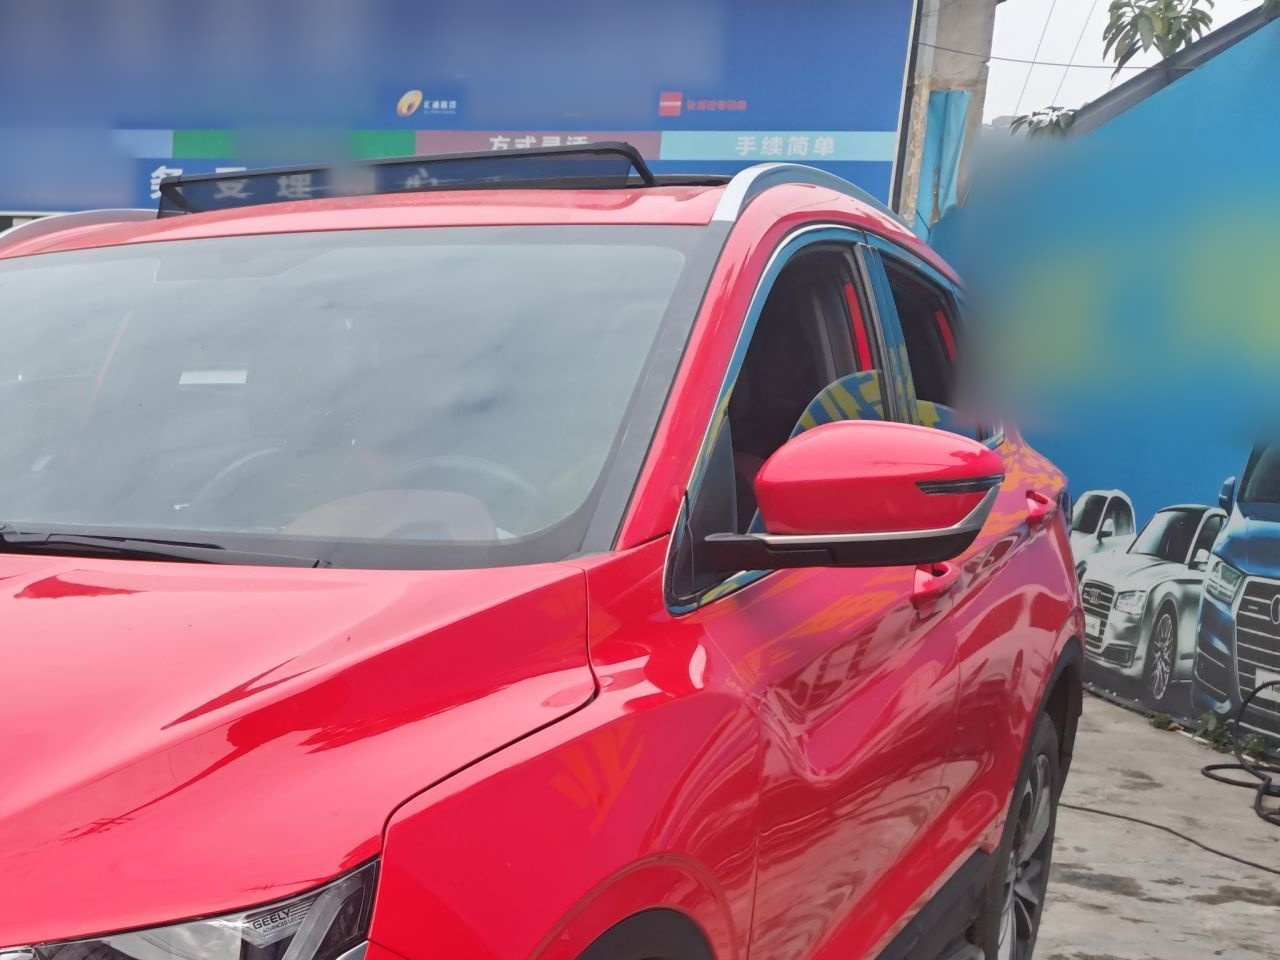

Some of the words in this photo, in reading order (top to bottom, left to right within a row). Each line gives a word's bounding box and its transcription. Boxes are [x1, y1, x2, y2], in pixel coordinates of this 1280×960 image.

[735, 136, 835, 156] 手续简单
[253, 909, 290, 929] GEELY
[263, 921, 287, 933] ADVANCED
